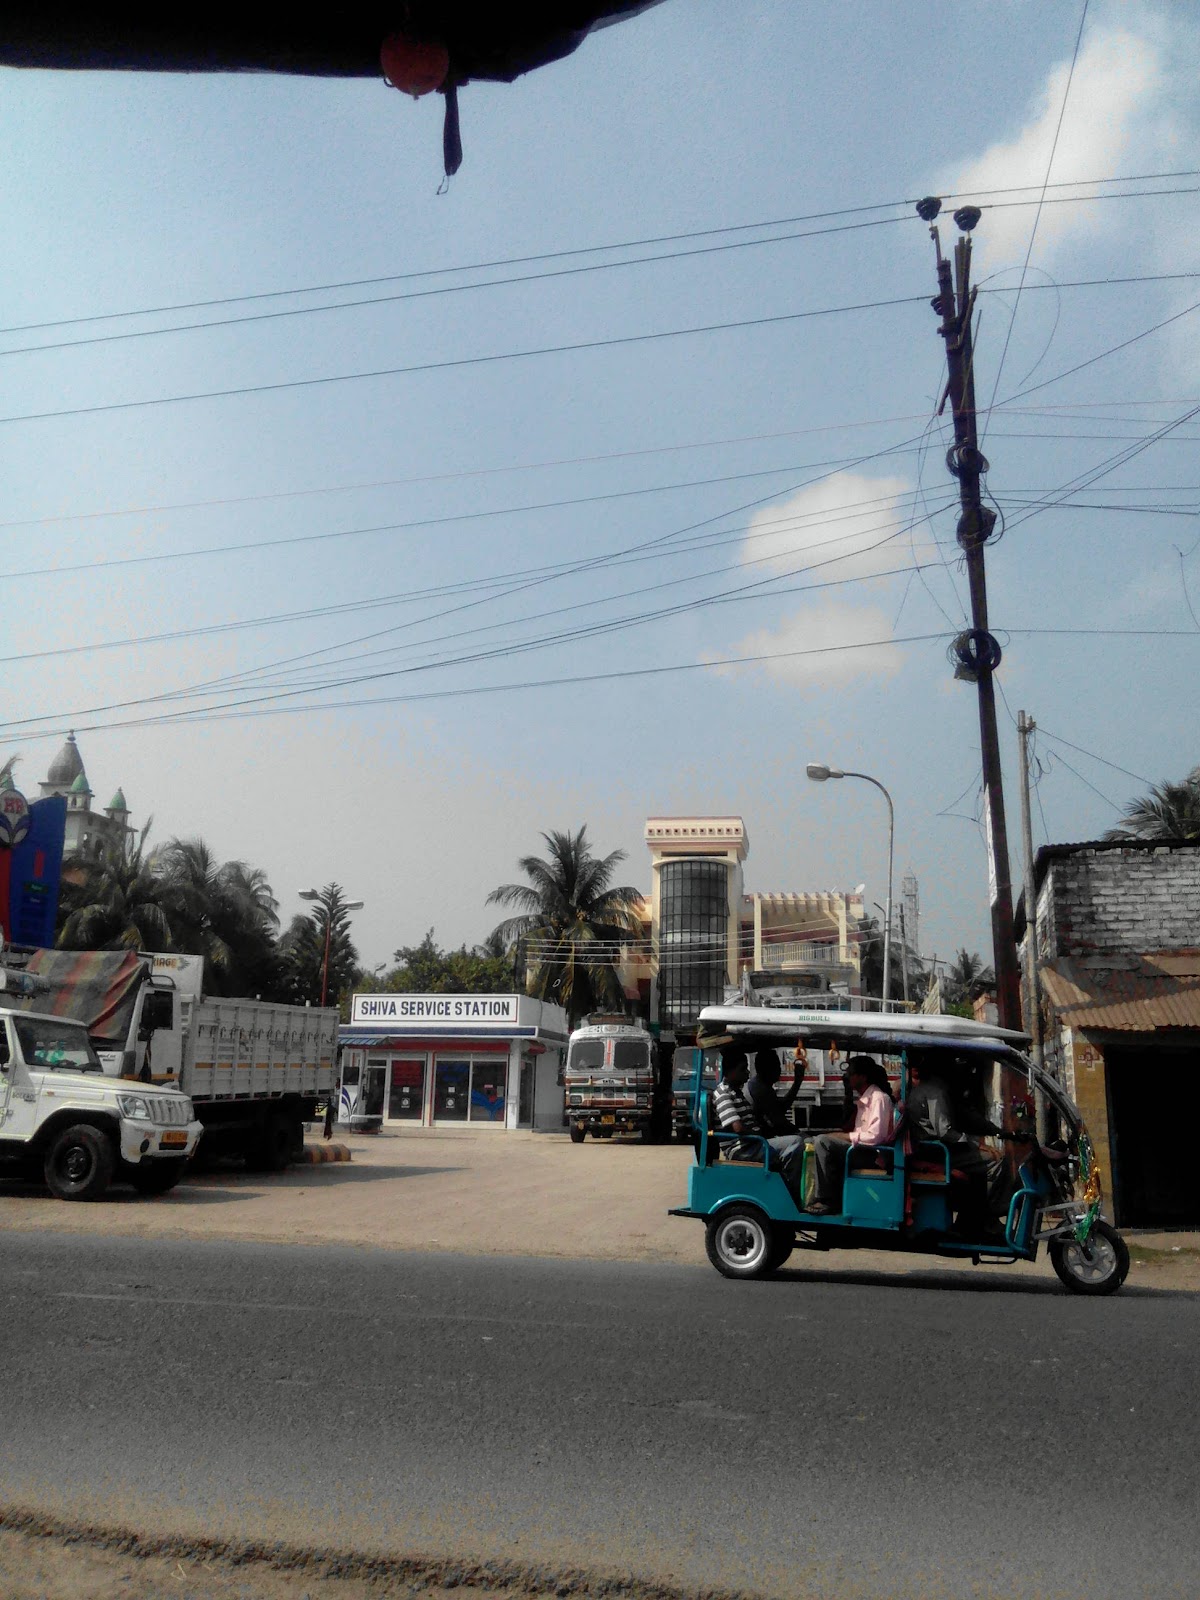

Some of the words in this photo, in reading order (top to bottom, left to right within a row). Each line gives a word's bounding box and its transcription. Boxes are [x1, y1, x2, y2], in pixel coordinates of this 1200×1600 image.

[361, 1001, 397, 1016] SHIVA
[400, 1001, 452, 1016] SERVICE
[454, 1001, 510, 1016] STATION
